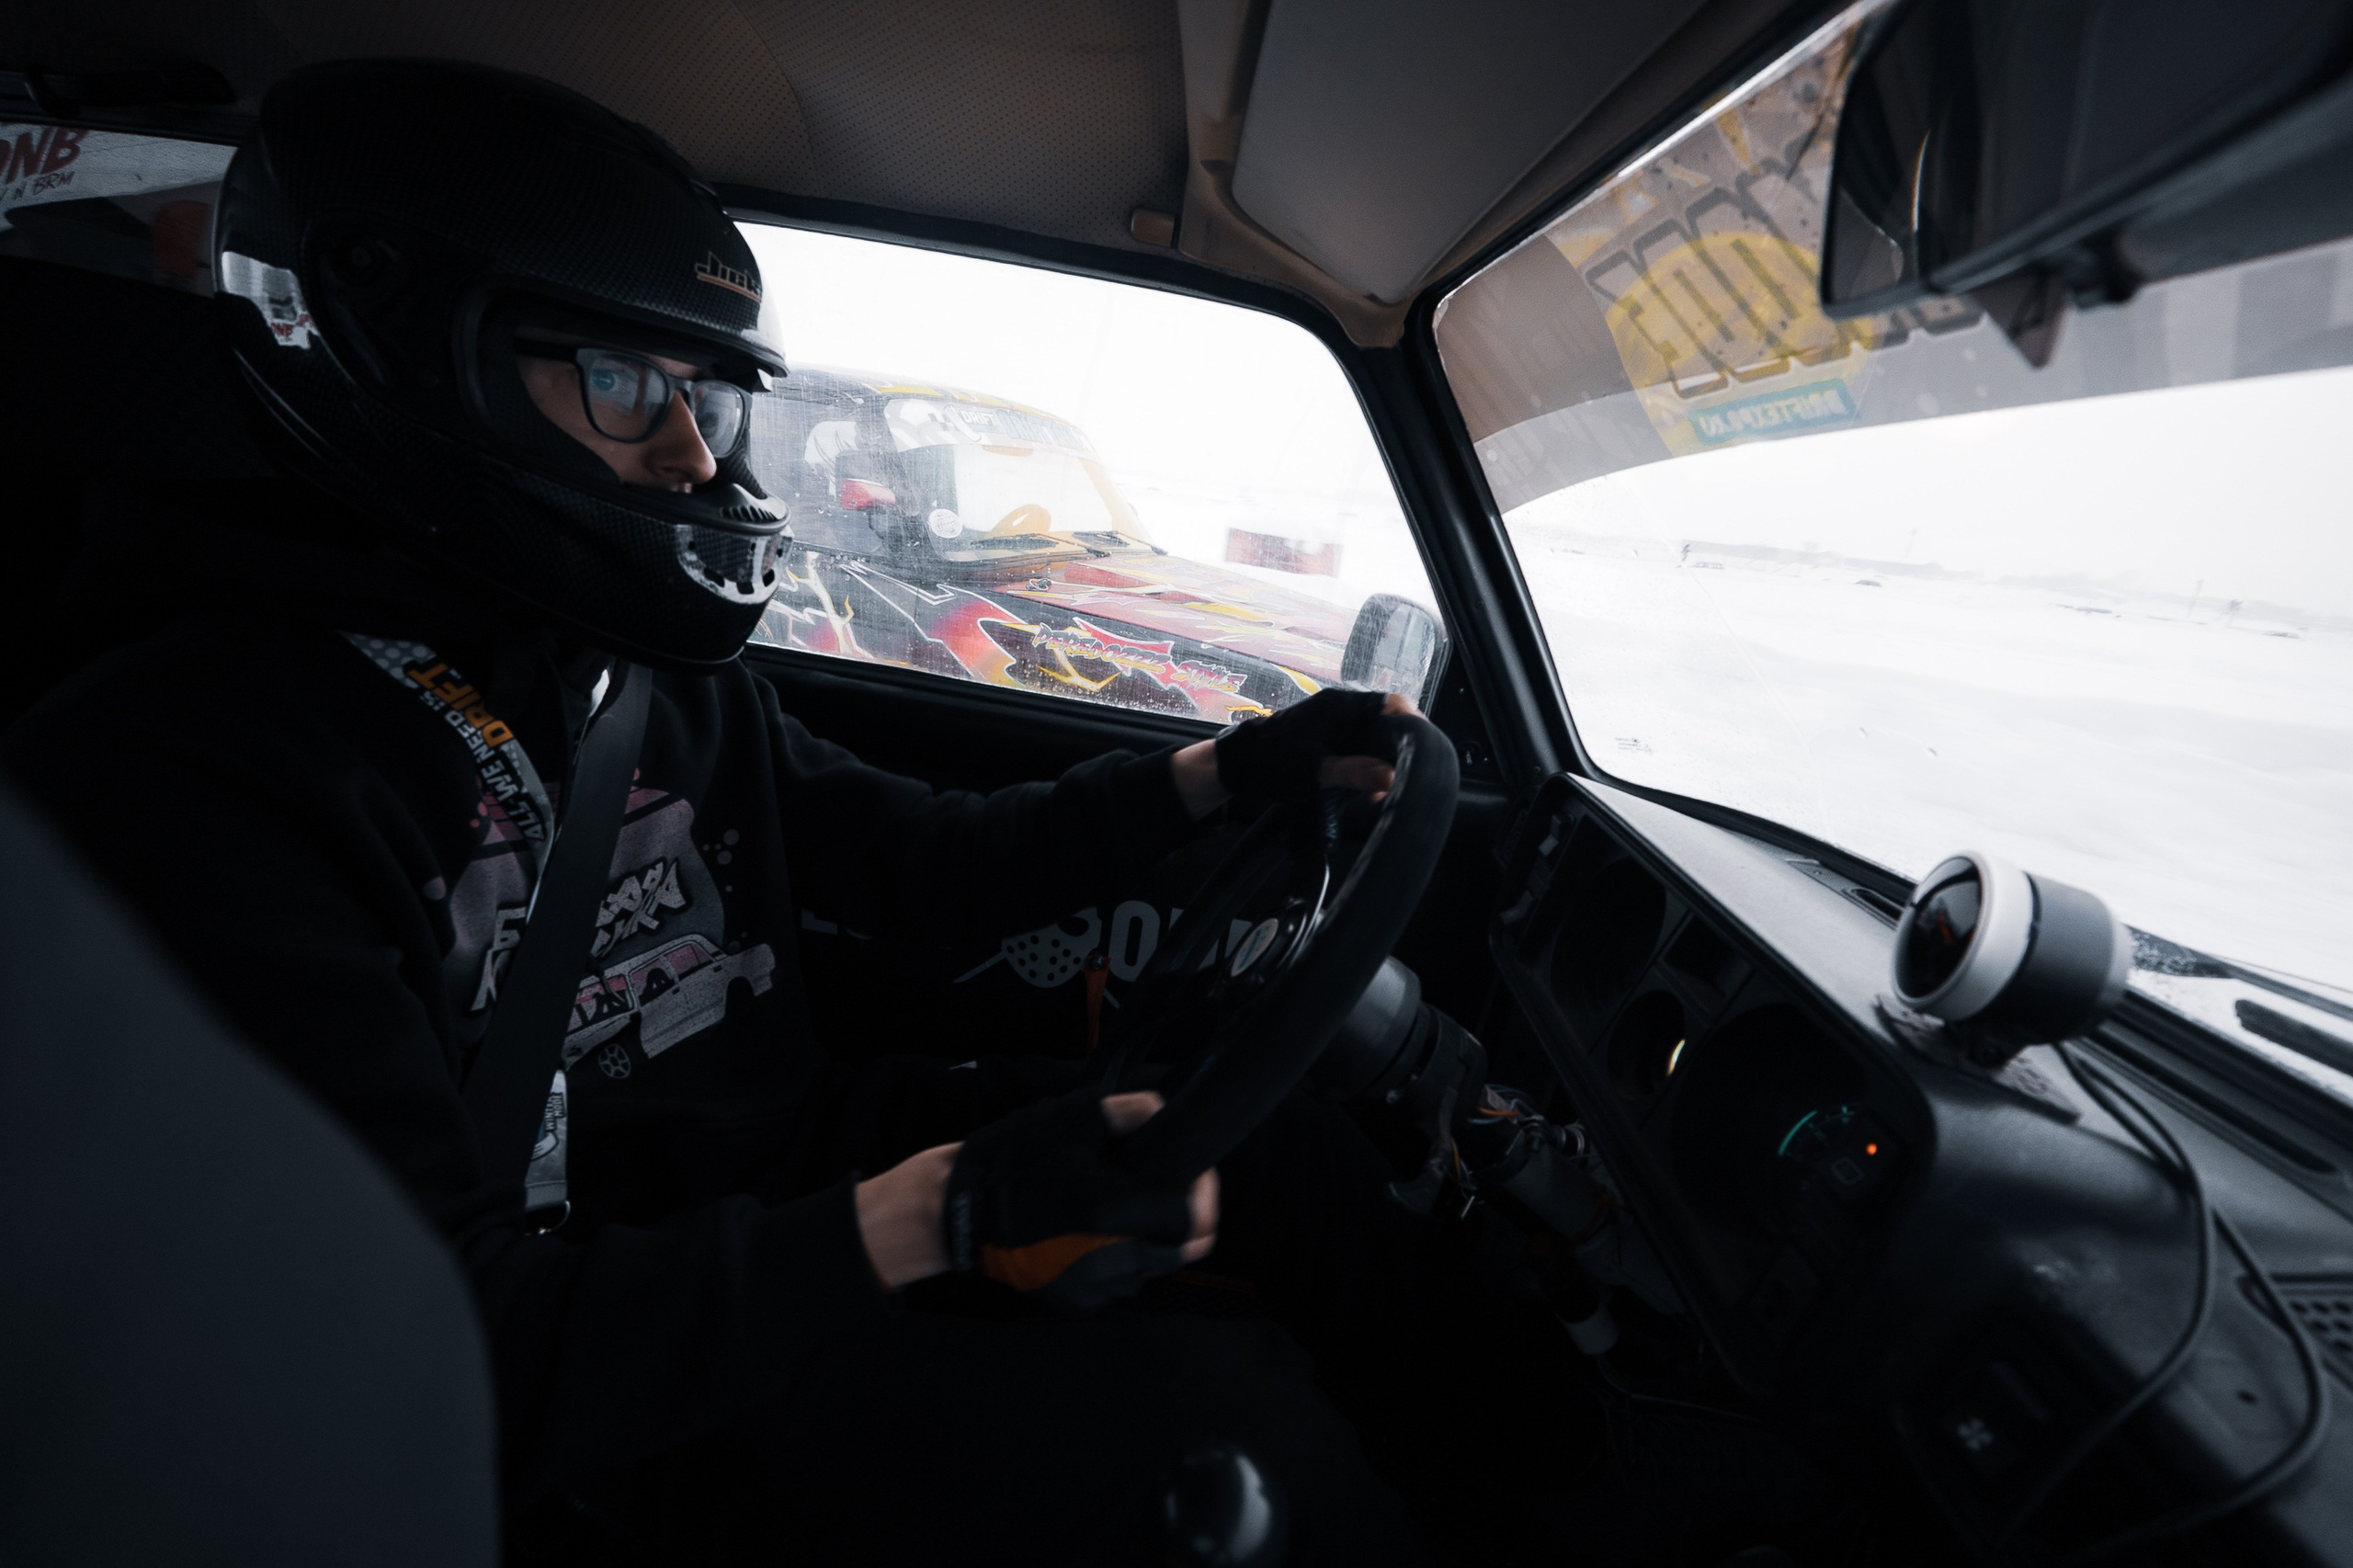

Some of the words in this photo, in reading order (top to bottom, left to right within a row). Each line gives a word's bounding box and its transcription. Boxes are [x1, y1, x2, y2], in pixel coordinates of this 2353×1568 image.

[961, 410, 997, 428] DRIFT
[405, 662, 515, 749] DRIFT
[419, 690, 447, 712] IS
[444, 709, 496, 764] NEED
[480, 759, 523, 802] WE
[508, 798, 546, 842] ALL
